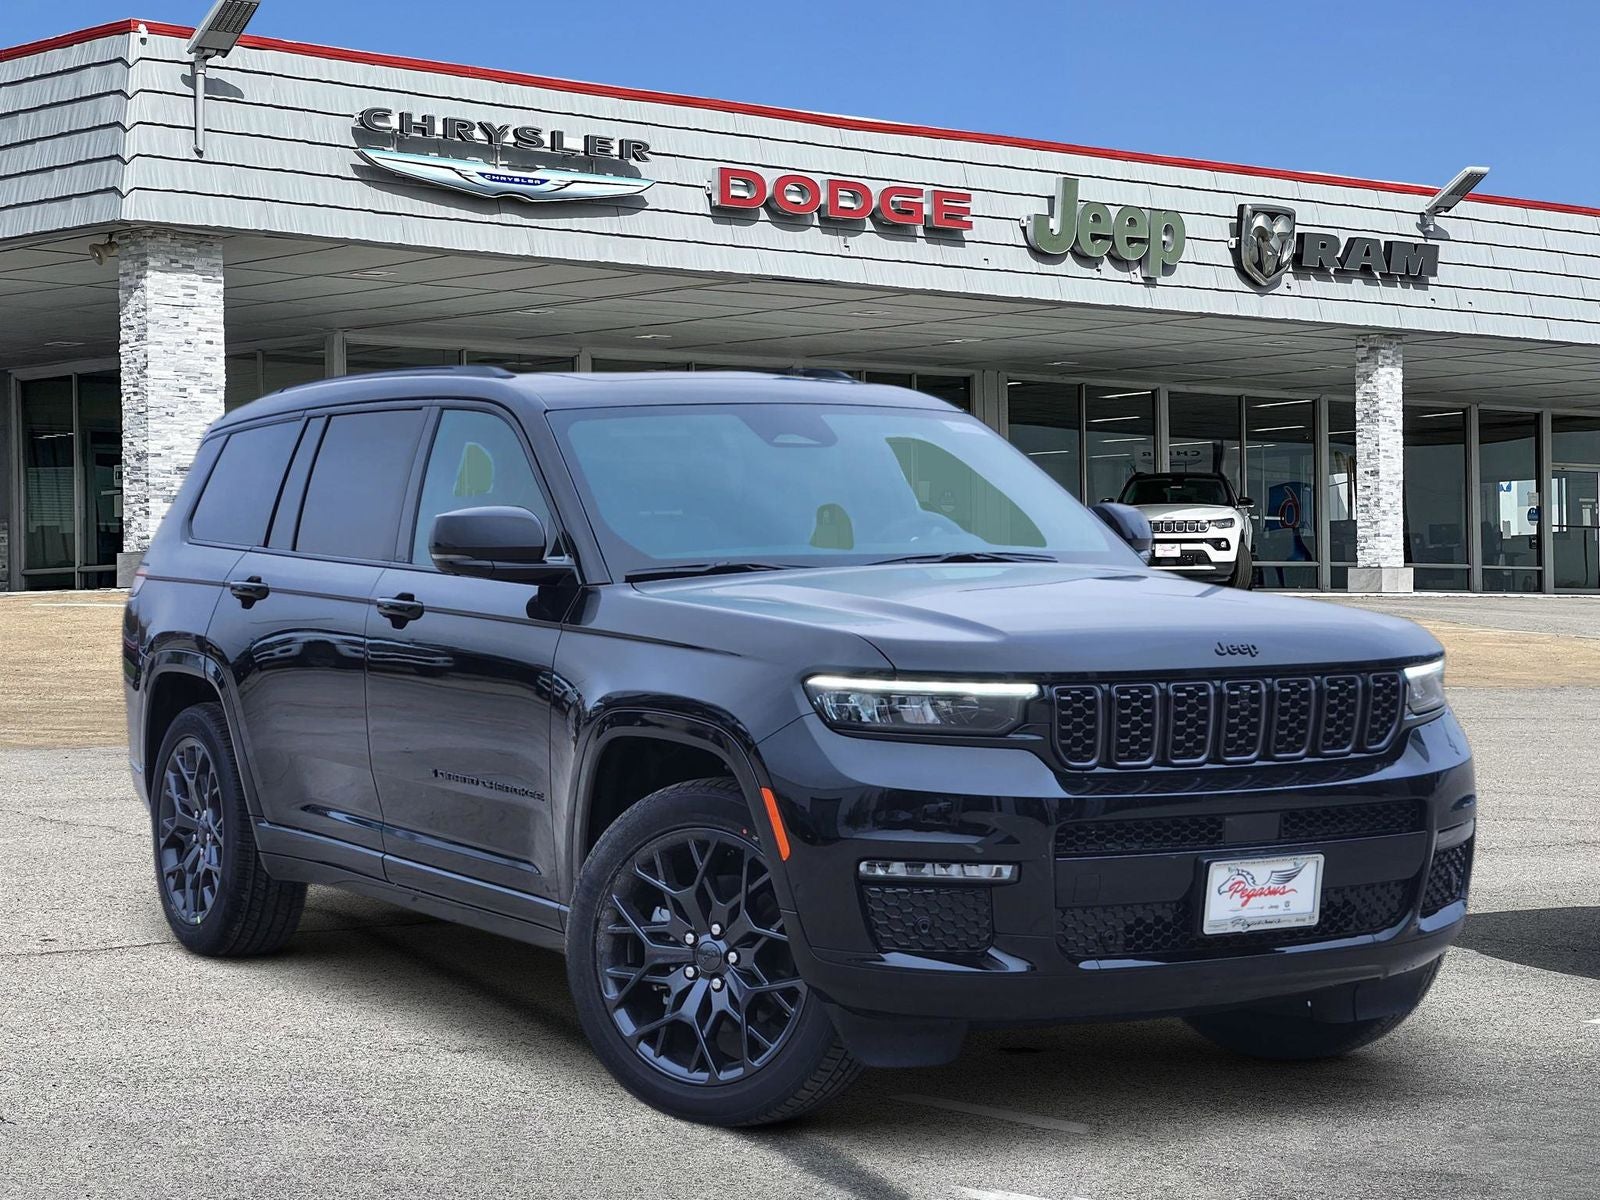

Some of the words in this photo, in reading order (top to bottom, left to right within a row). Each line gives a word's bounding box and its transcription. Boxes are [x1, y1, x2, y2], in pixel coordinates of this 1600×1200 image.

[358, 106, 651, 162] CHRYSLER
[484, 174, 541, 185] CHRYSLER
[712, 167, 973, 231] DODGE
[1027, 177, 1185, 278] Jeep
[1297, 232, 1440, 277] RAM
[1214, 641, 1260, 658] Jeep
[1228, 880, 1298, 908] Pegasus
